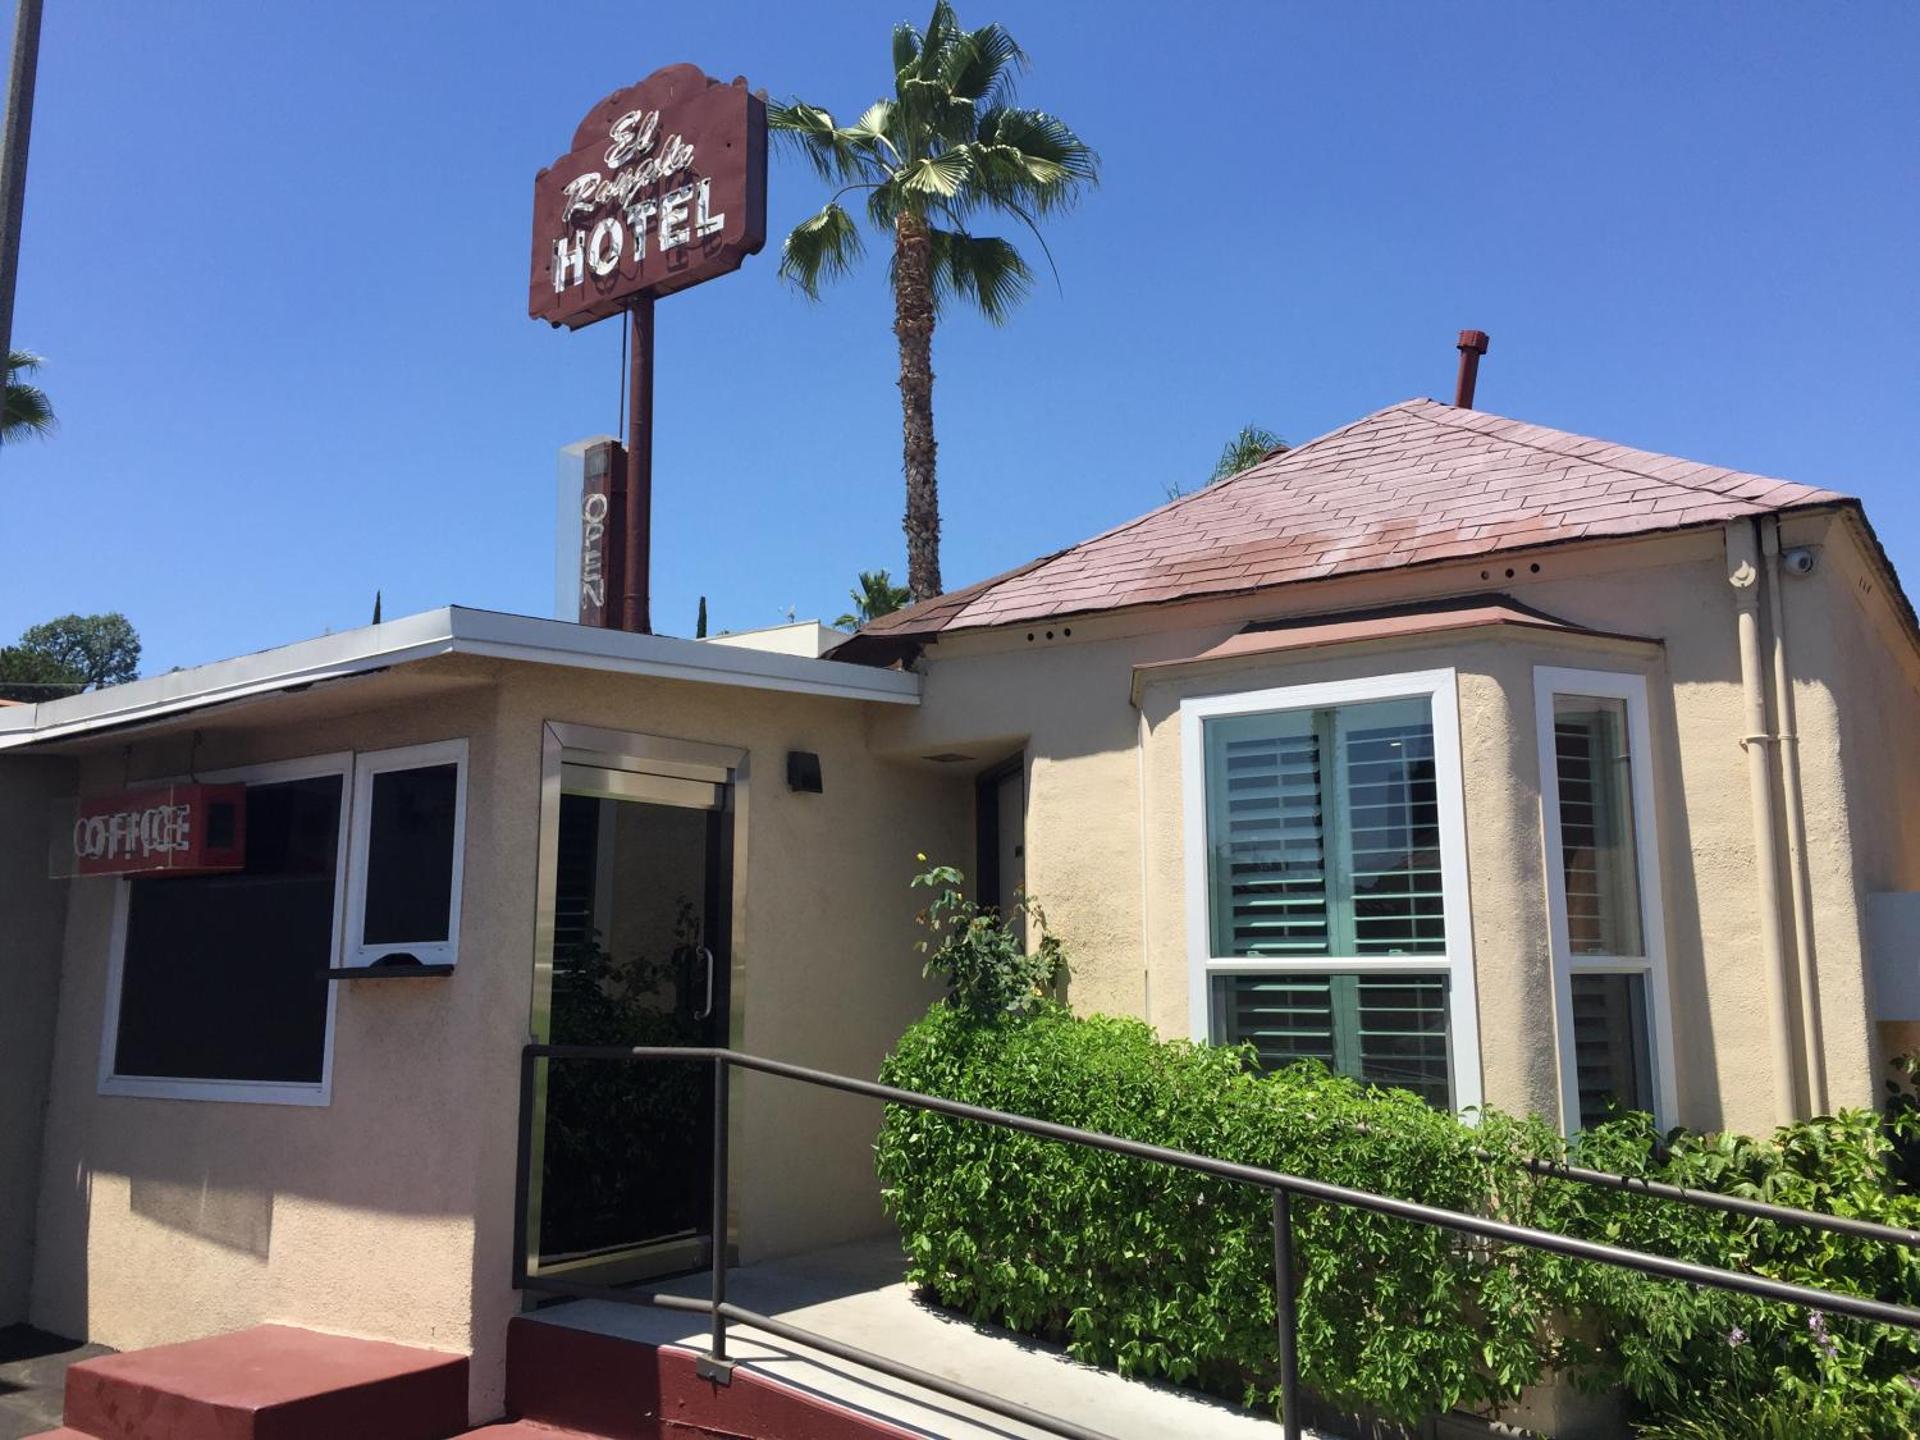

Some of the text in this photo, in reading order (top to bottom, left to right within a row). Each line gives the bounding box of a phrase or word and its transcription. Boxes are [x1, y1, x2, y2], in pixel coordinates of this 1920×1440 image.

[604, 110, 659, 168] El
[553, 177, 725, 293] HOTEL
[583, 493, 608, 609] OPEN
[74, 804, 190, 859] OFFICE
